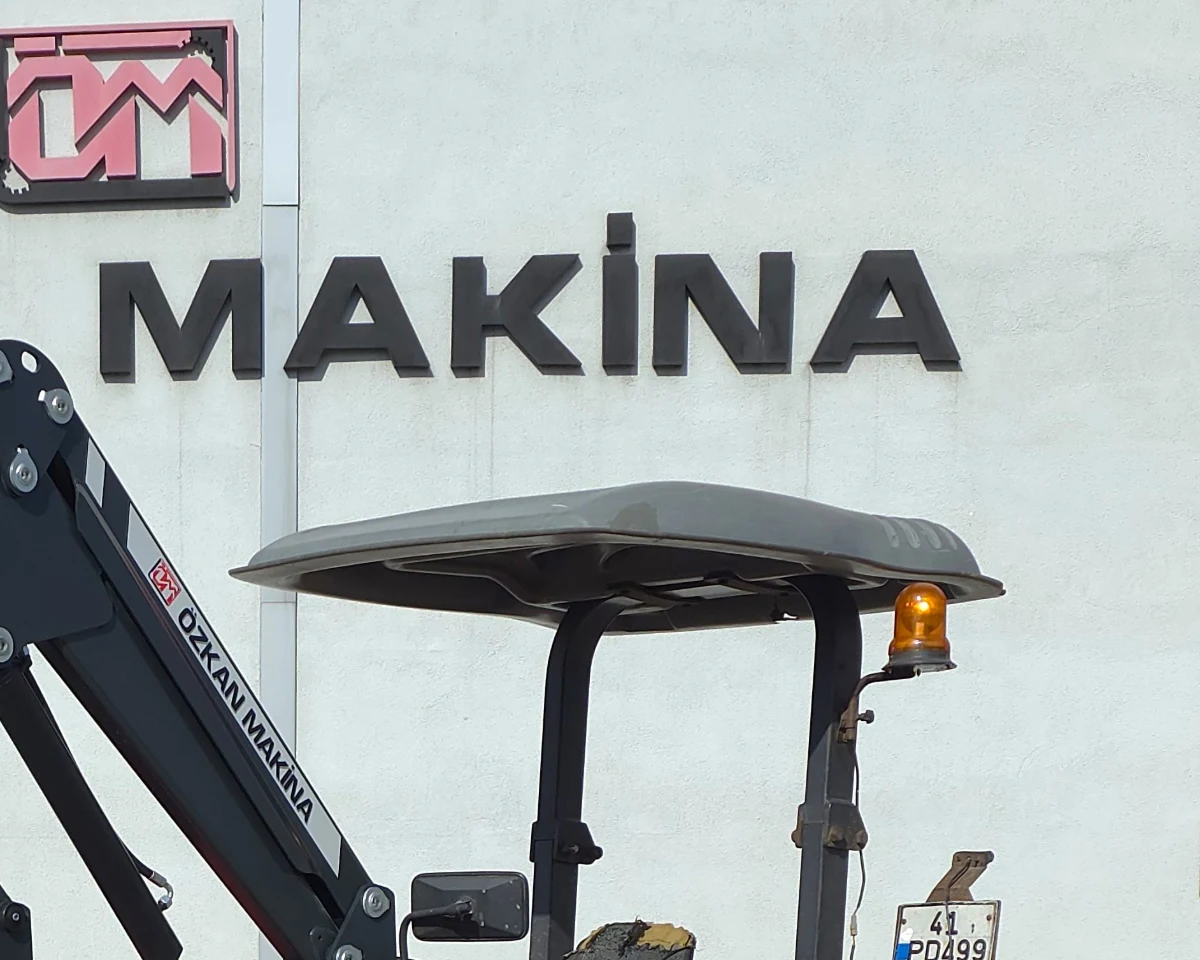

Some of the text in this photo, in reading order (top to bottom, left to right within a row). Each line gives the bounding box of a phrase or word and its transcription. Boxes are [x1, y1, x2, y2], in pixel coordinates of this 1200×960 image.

[99, 212, 961, 382] MAKİNA
[177, 606, 315, 826] ÖZKAN MAKİNA
[930, 911, 959, 936] 41
